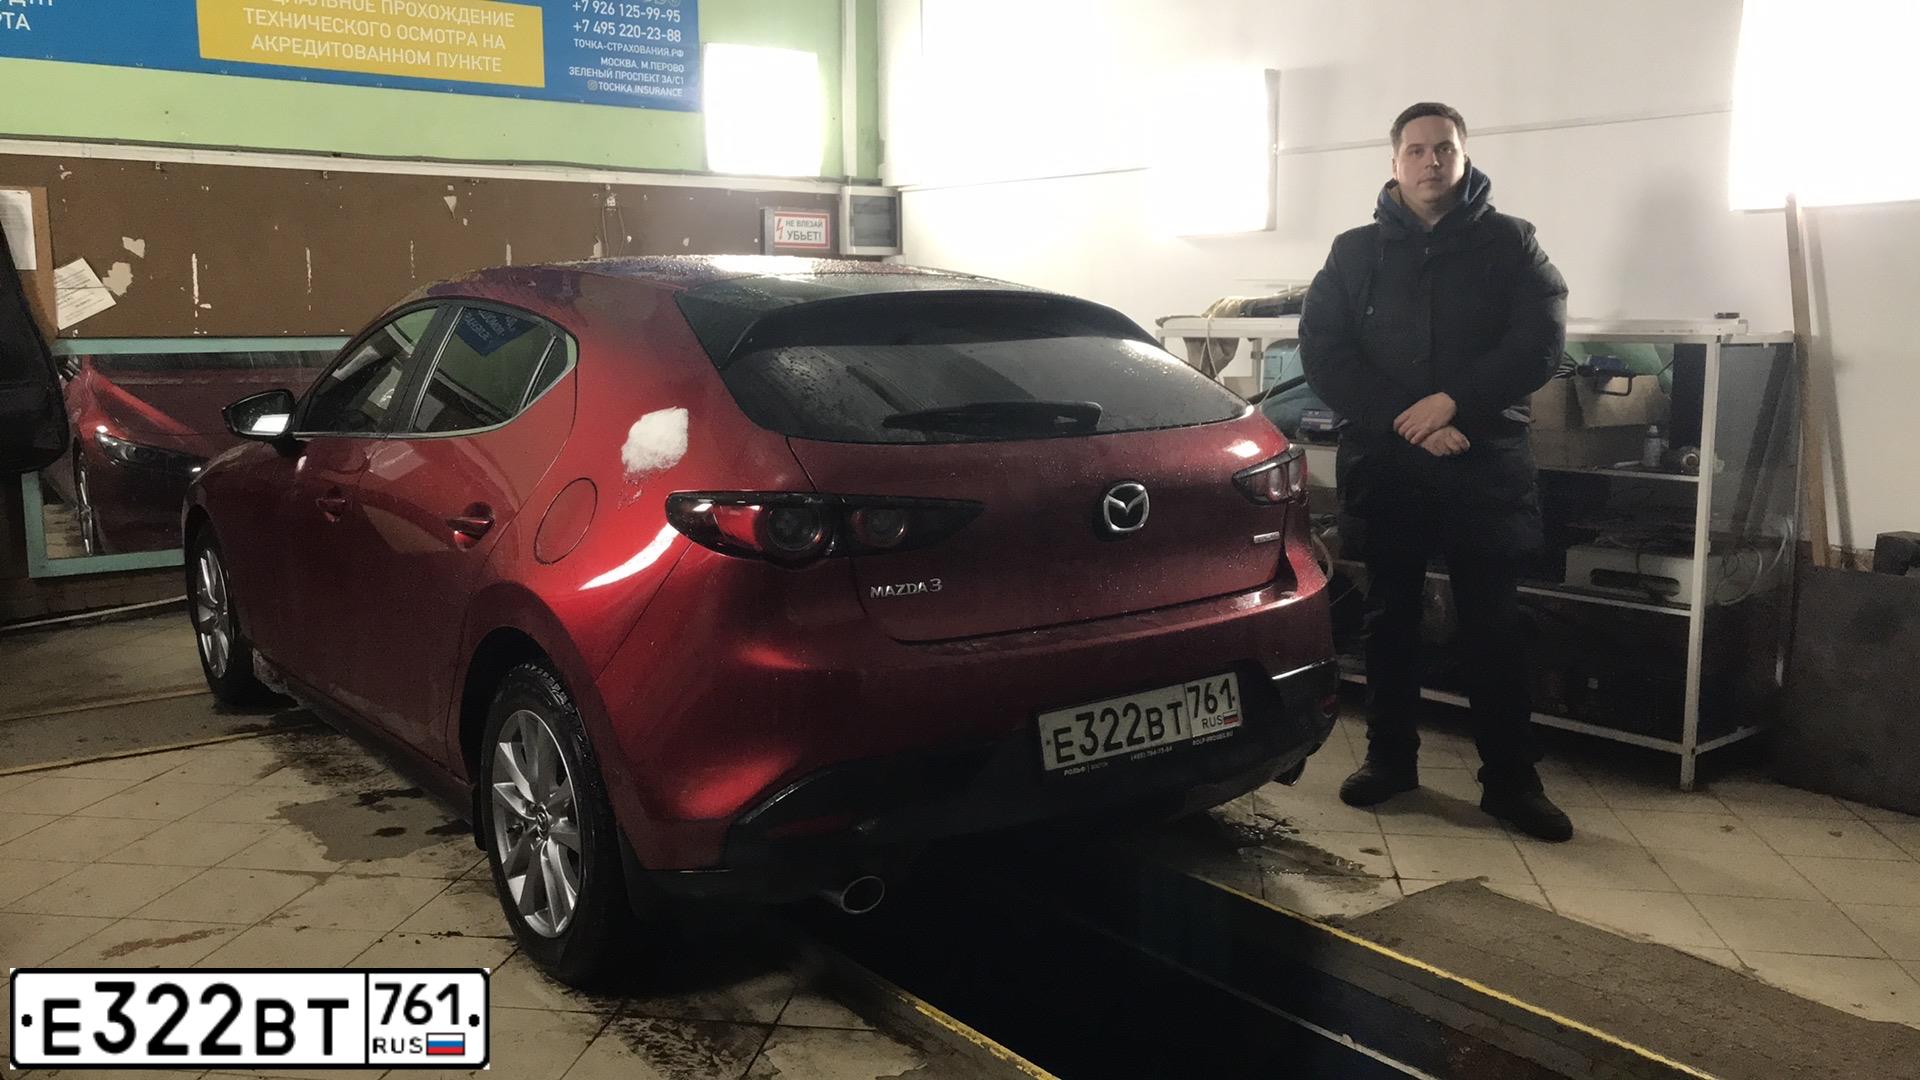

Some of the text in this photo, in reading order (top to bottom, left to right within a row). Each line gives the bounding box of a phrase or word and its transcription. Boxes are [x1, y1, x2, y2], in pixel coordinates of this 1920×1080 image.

[0, 11, 31, 31] ТА
[381, 0, 515, 28] ПРОХОЖДЕНИЕ
[572, 0, 681, 23] +7 926 125-99-95
[243, 7, 506, 50] ТЕХНИЧЕСКОГО ОСМОТРА НА
[573, 19, 682, 43] +7 495 220-23-88
[251, 33, 502, 73] АКРЕДИТОВАННОМ ПУНКТЕ
[573, 38, 684, 58] ТОЧКА-СТРАХОВАНИЯ.РФ
[568, 66, 613, 80] ЗЕЛЕНЫЙ
[615, 70, 660, 84] ПРОСПЕКТ
[598, 81, 683, 98] TOCHKA.INSURANCE
[785, 219, 796, 228] НЕ
[1187, 678, 1235, 719] 761
[1201, 715, 1223, 729] RUS
